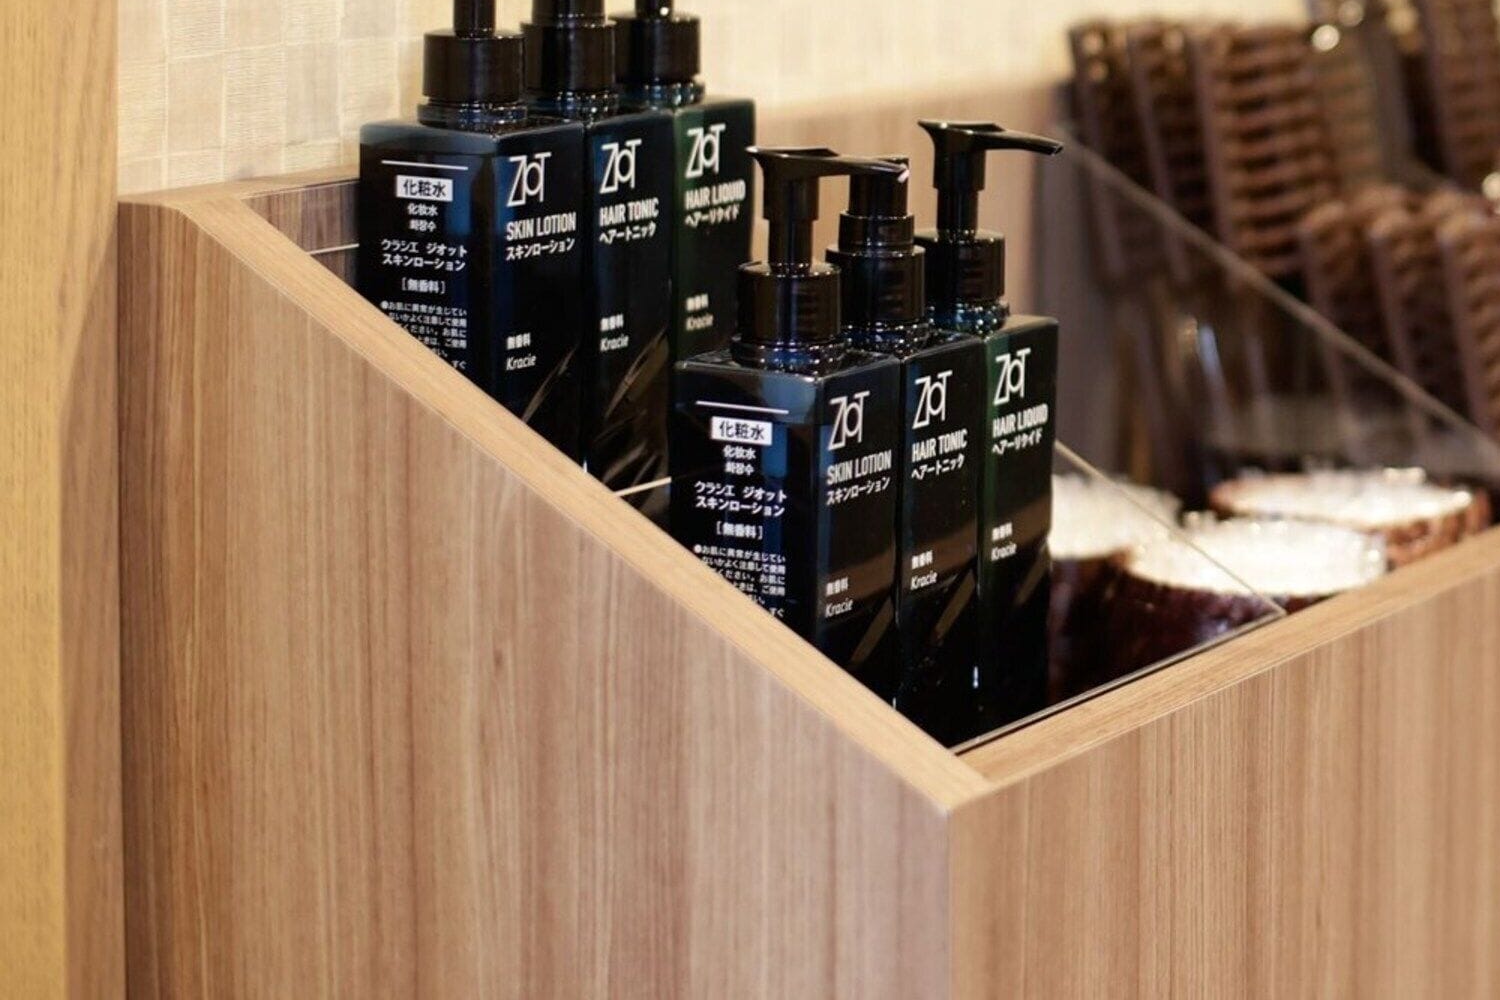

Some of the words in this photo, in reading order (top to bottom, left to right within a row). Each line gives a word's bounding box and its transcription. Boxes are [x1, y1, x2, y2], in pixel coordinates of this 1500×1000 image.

[403, 179, 446, 198] 化粧水
[685, 188, 710, 210] HAIR
[712, 179, 746, 204] LIQUID
[600, 203, 626, 227] HAIR
[628, 197, 659, 221] TONIC
[506, 218, 534, 241] SKIN
[536, 211, 577, 237] LOTION
[600, 221, 656, 245] ヘアートニック
[381, 238, 419, 253] クラシエ
[426, 242, 467, 258] ジオット
[506, 237, 575, 261] スキンローション
[382, 253, 466, 271] スキンローション
[600, 334, 630, 352] Kracie
[506, 353, 537, 371] Kracie
[718, 420, 764, 441] 化粧水
[993, 413, 1017, 439] HAIR
[1017, 402, 1048, 432] LIQUID
[912, 438, 937, 463] HAIR
[938, 428, 968, 455] TONIC
[826, 460, 853, 485] SKIN
[854, 449, 892, 478] LOTION
[911, 452, 965, 480] ヘアートニック
[695, 480, 735, 497] クラシエ
[743, 486, 787, 503] ジオット
[826, 476, 891, 506] スキンローション
[695, 495, 785, 517] スキンローション
[910, 570, 938, 590] Kracie
[825, 598, 853, 618] Kracie
